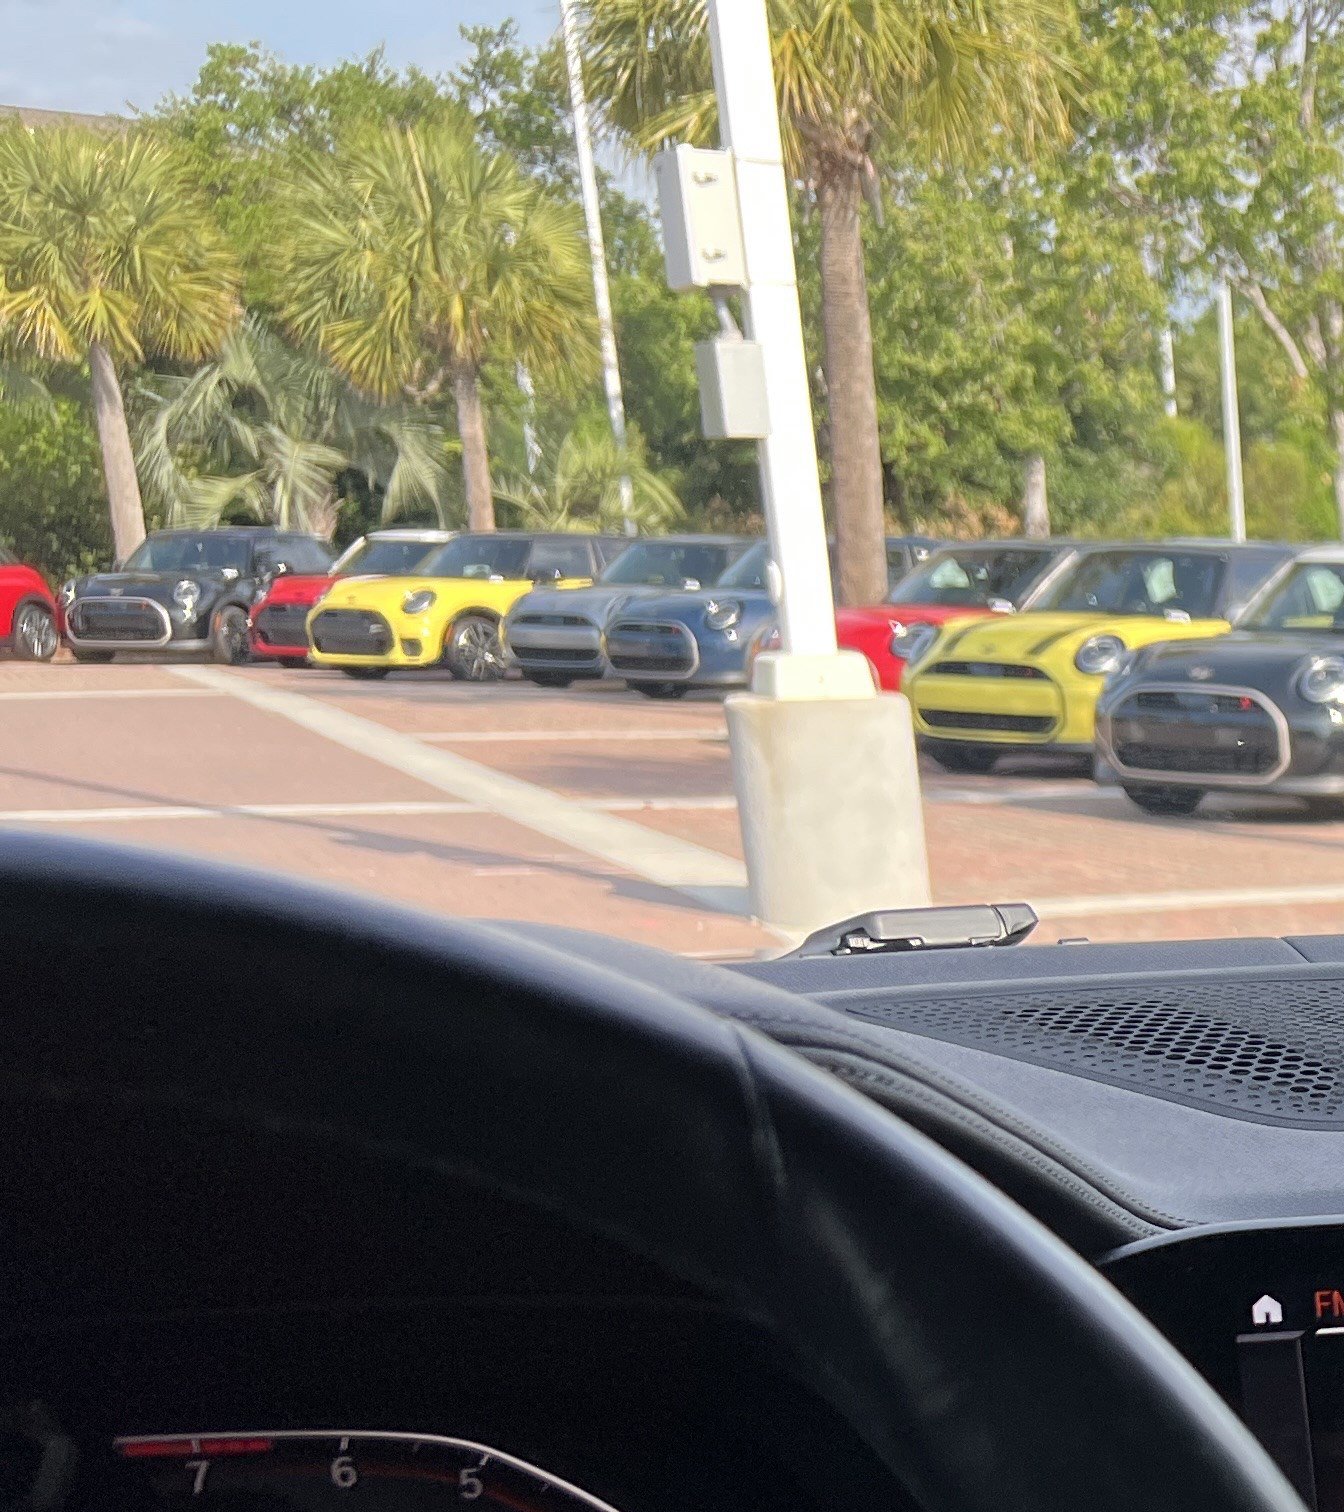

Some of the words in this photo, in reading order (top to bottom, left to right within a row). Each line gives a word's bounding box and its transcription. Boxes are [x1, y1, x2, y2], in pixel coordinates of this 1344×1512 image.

[186, 1461, 209, 1495] 7
[330, 1458, 358, 1489] 6
[459, 1469, 484, 1499] 5
